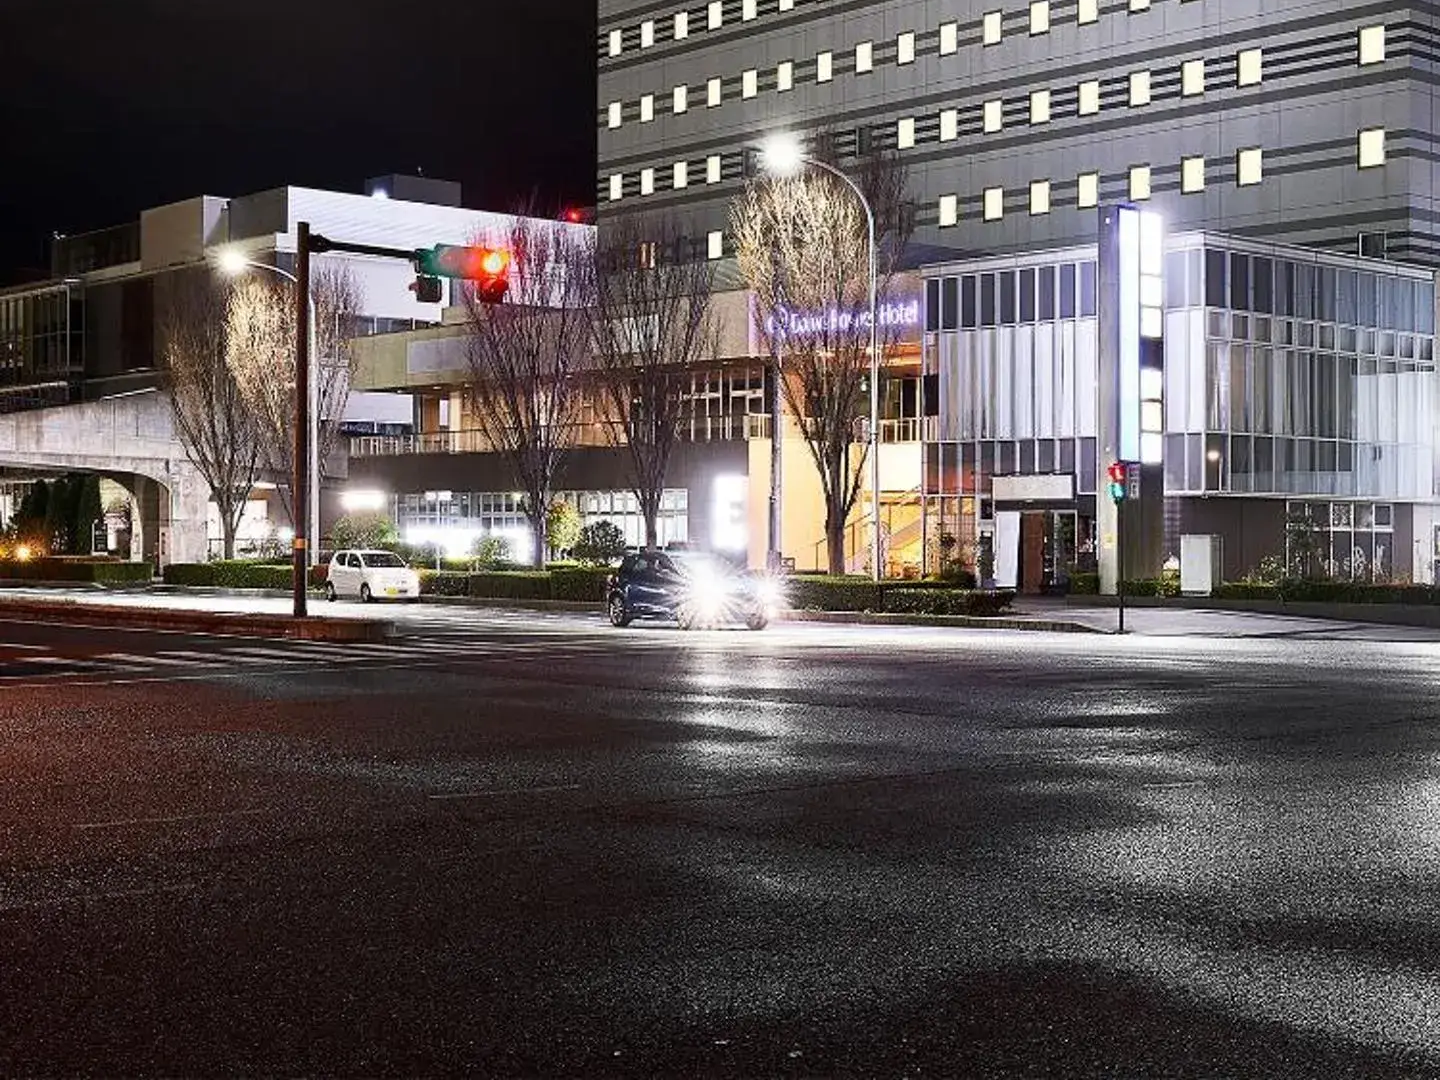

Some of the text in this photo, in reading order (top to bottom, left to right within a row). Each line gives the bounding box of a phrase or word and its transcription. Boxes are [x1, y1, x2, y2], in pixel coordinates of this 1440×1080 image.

[790, 299, 919, 333] Daw Rone Hotel
